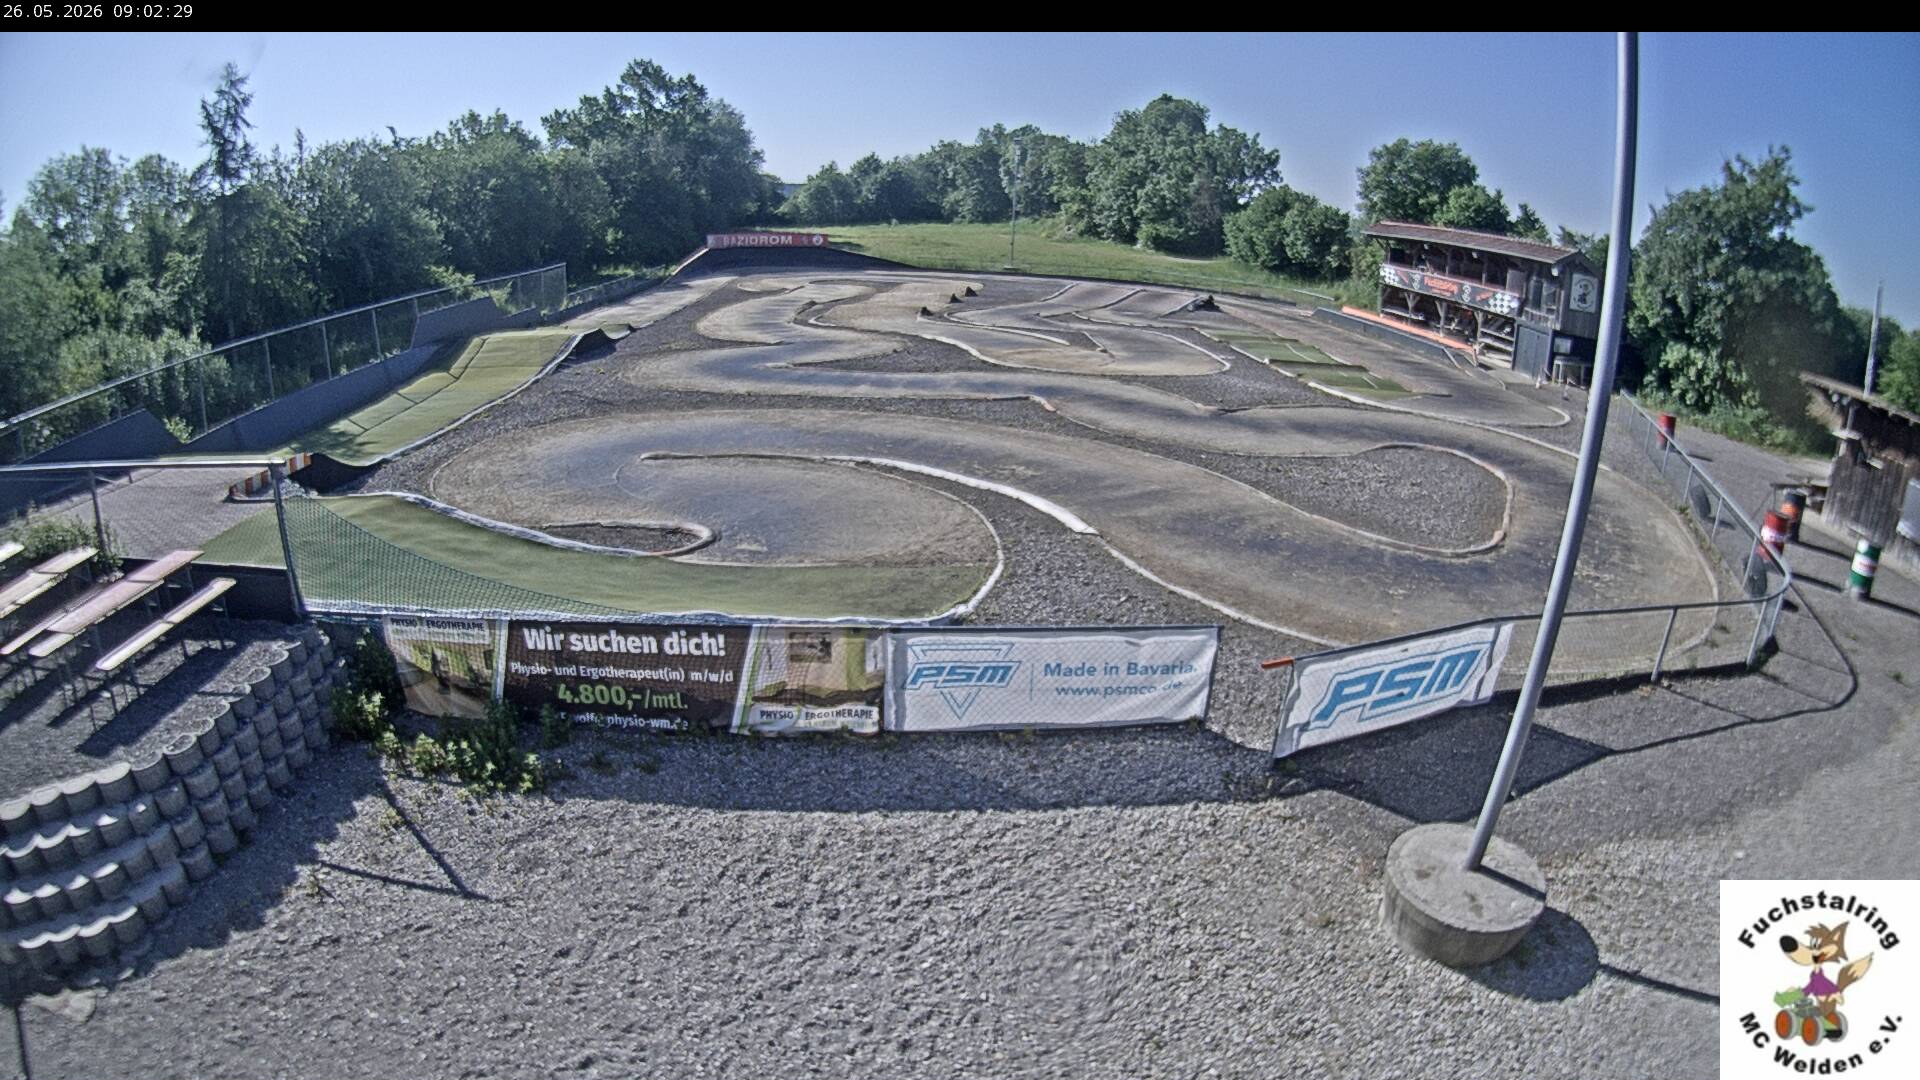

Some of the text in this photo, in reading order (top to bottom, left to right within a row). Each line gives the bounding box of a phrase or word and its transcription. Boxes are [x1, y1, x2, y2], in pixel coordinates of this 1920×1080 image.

[426, 619, 485, 631] ERGOTHERAPIE
[523, 626, 727, 656] Wir suchen dich!
[510, 661, 734, 683] Physio- und Ergotherapeut(in) m/w/d
[909, 664, 1014, 686] PSM
[1043, 661, 1097, 677] Made
[1103, 661, 1120, 677] in
[1312, 648, 1484, 723] PSM
[759, 708, 874, 721] PHYSIO ERGOTHERAPIE
